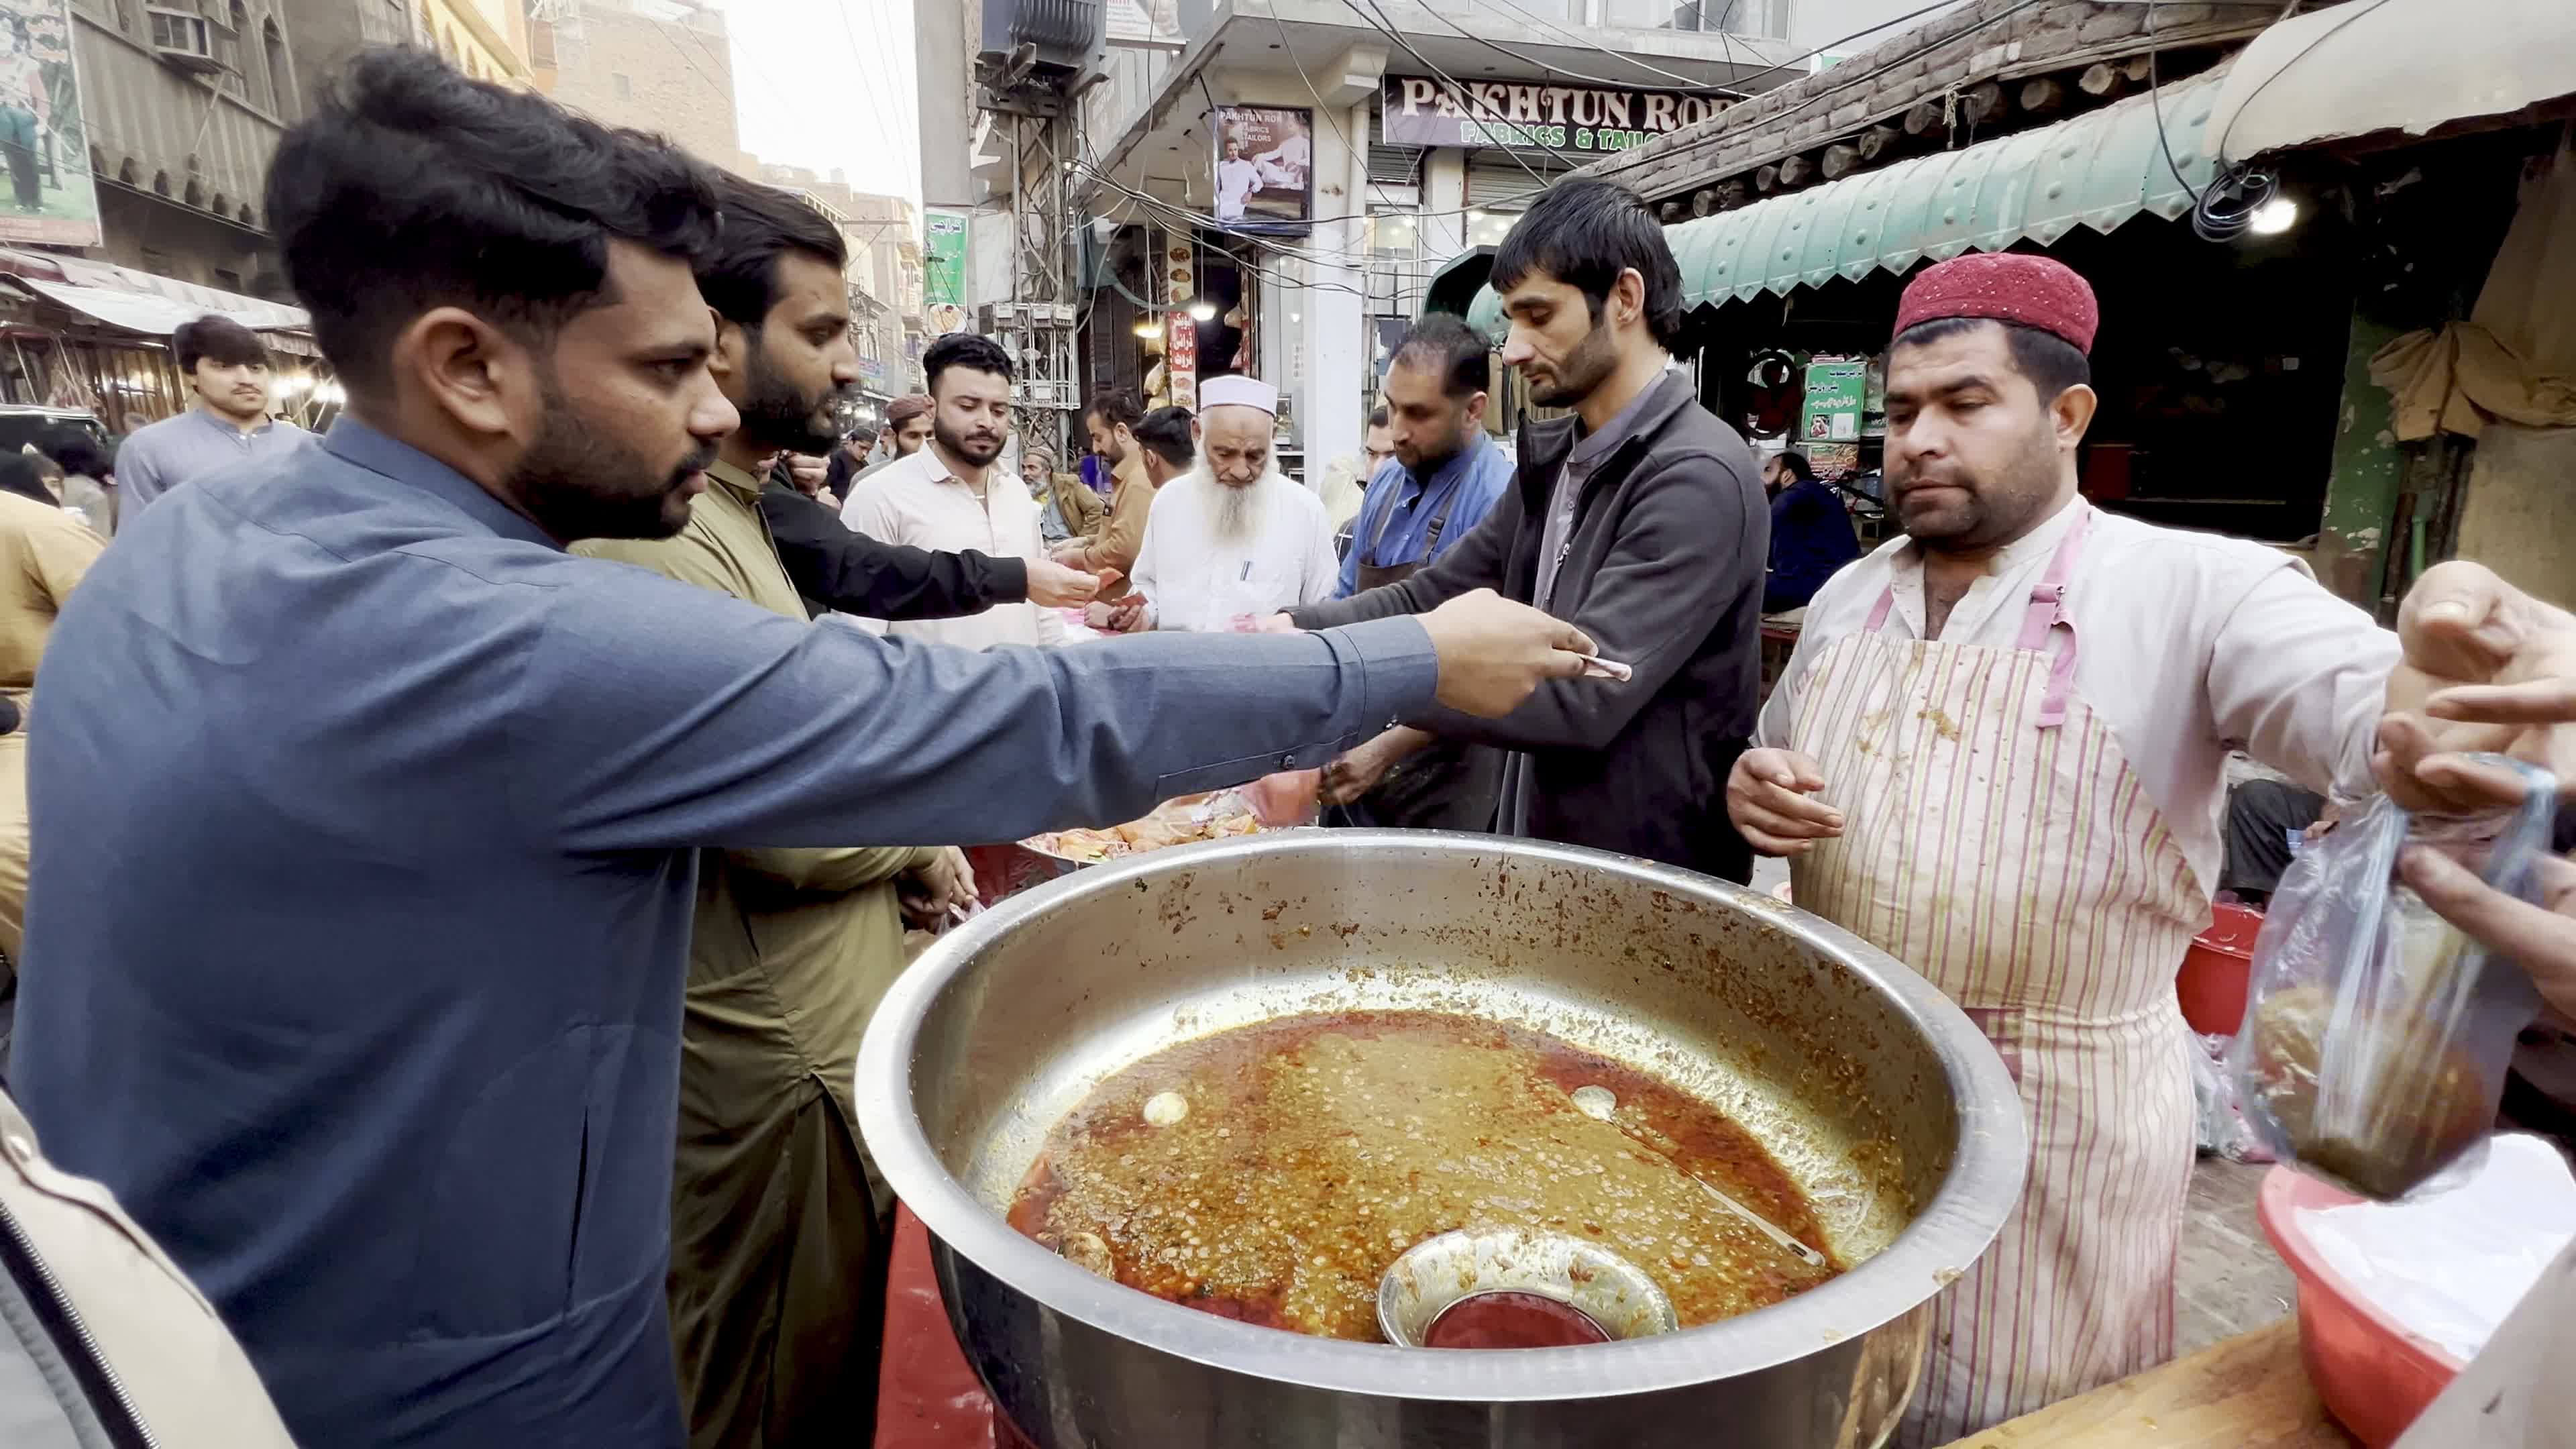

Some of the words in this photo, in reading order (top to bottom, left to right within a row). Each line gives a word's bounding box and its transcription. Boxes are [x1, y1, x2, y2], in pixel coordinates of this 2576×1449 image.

[1220, 111, 1262, 123] PAKHTUN
[1401, 77, 1633, 129] PAKHTUN
[1459, 120, 1567, 148] FABRICS
[1575, 127, 1594, 149] &
